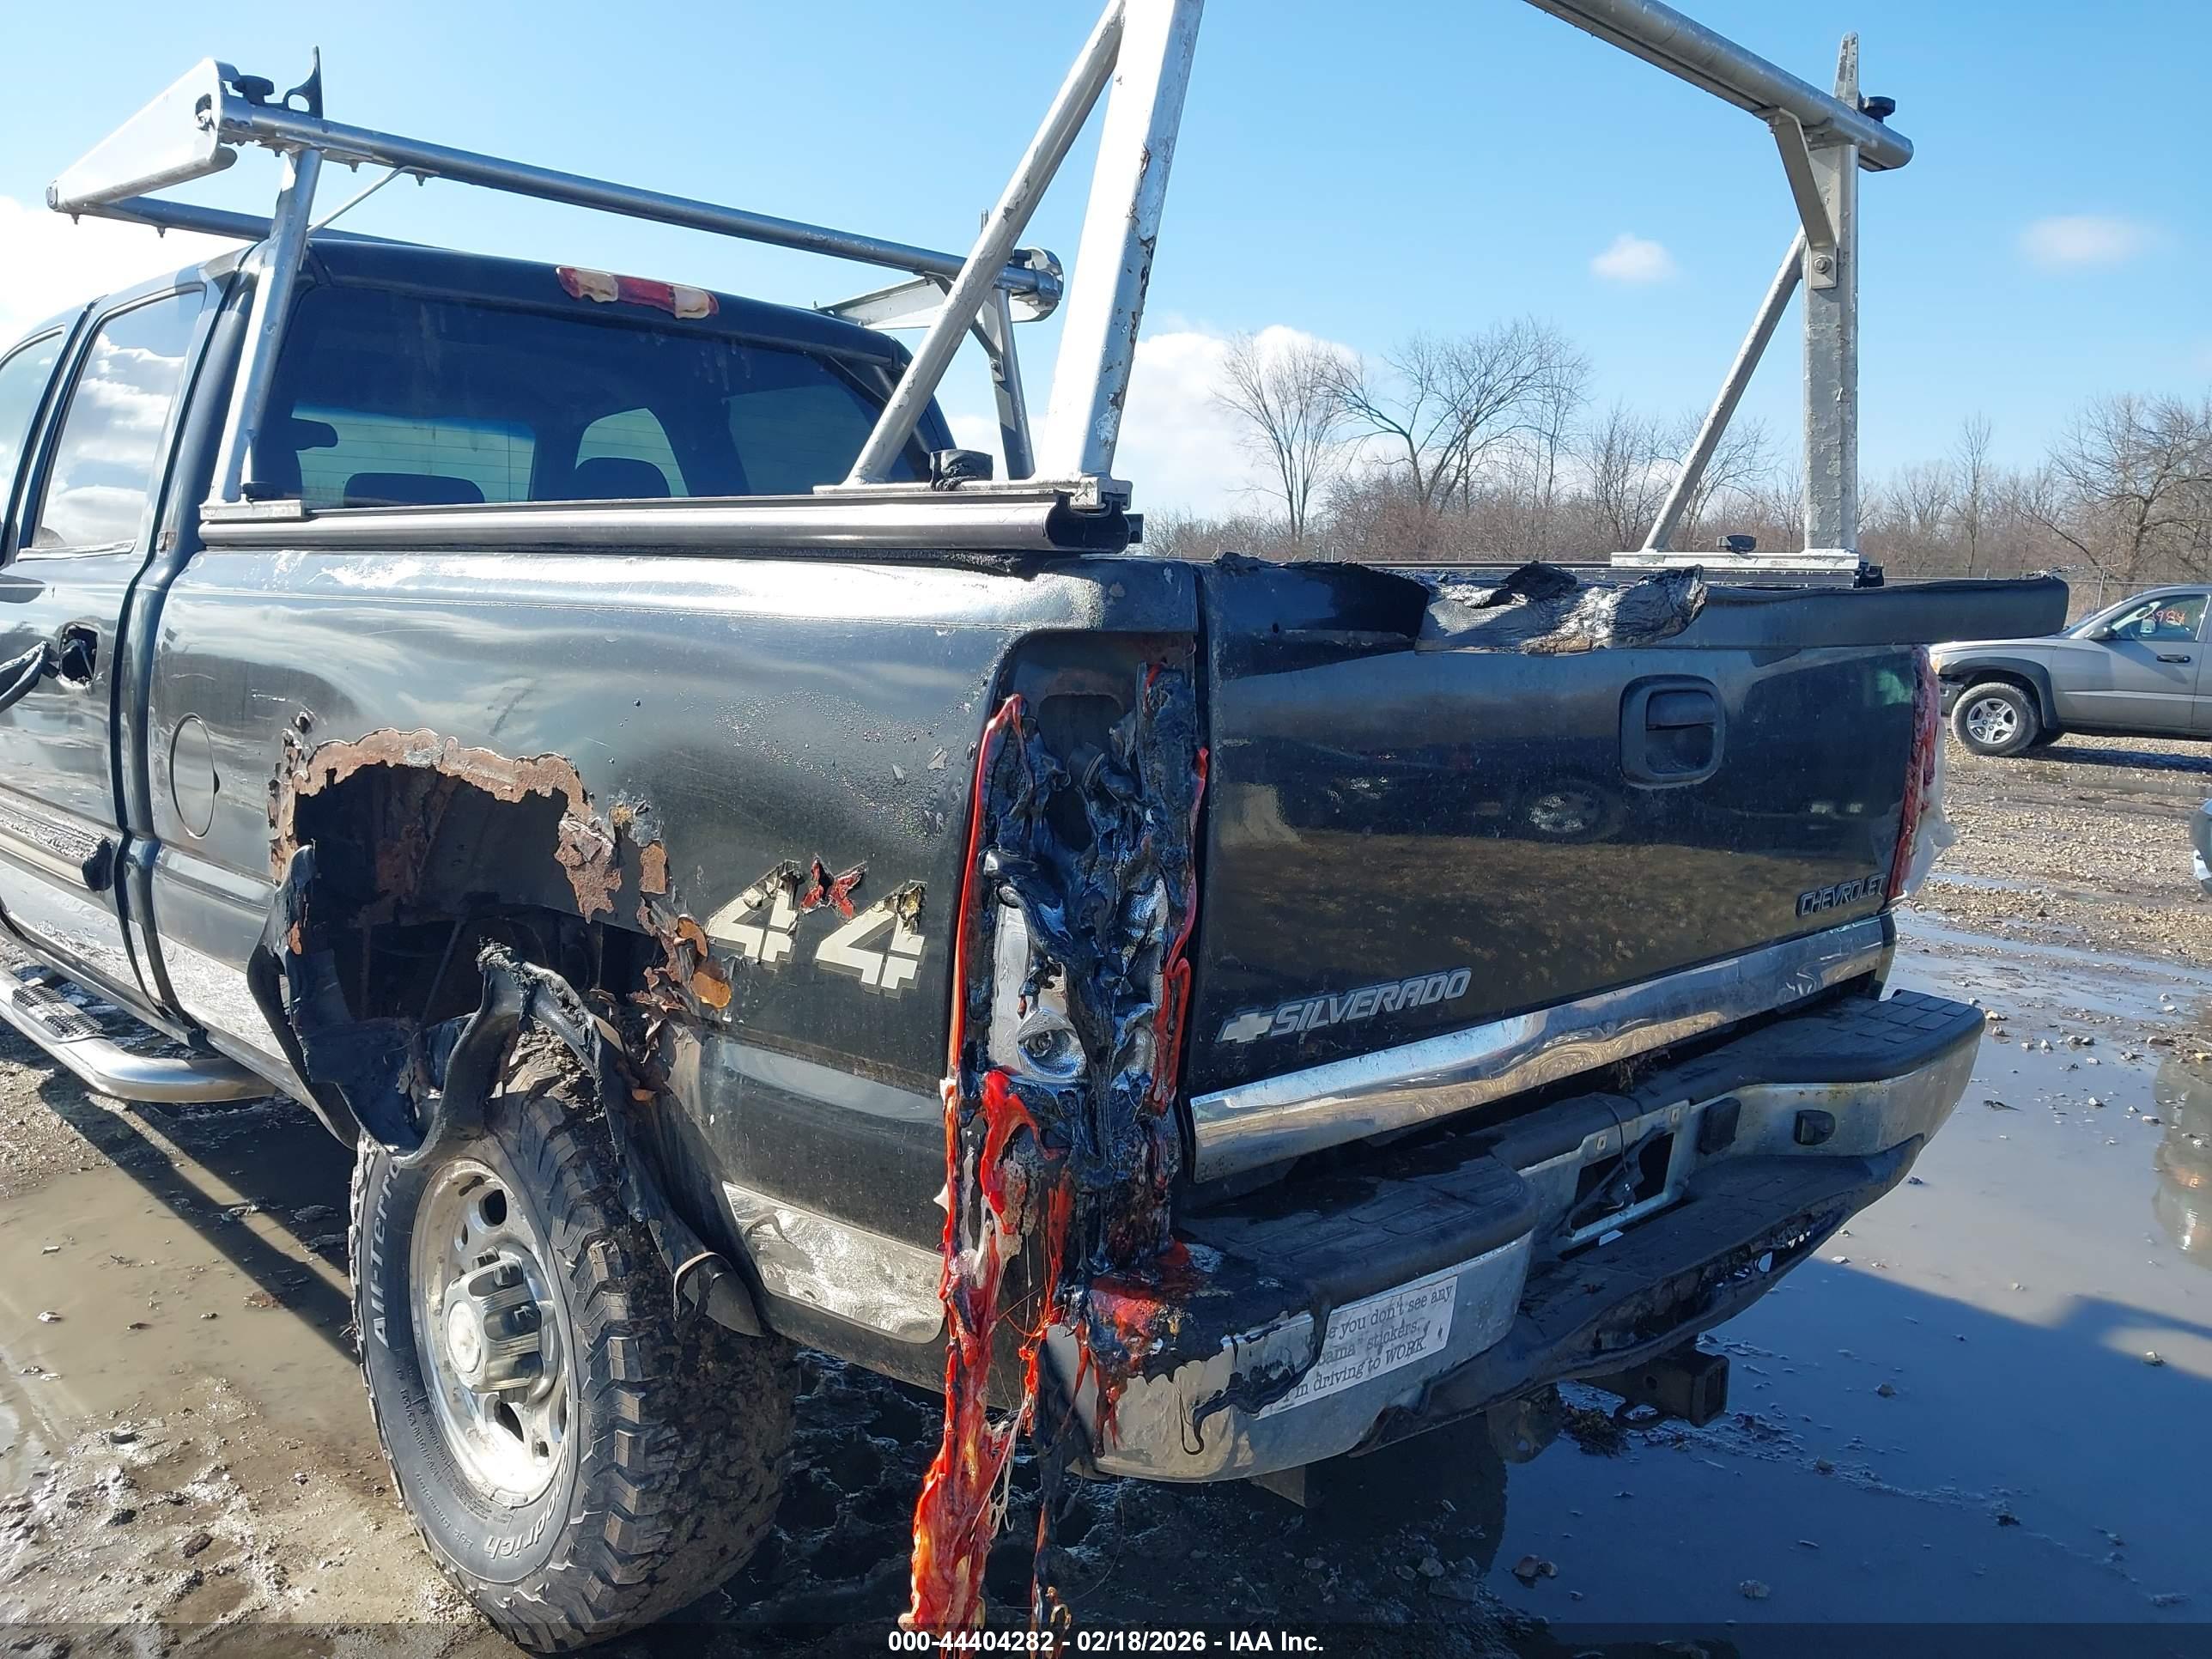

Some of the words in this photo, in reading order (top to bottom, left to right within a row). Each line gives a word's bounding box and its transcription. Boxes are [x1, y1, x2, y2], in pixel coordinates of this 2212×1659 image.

[1800, 873, 1887, 916] CHEVROLET
[1270, 969, 1473, 1037] SILVERADO
[370, 1160, 402, 1349] All-Terra
[1339, 1314, 1366, 1340] you
[1370, 1296, 1405, 1326] don't
[1408, 1296, 1427, 1313] see
[1431, 1285, 1453, 1303] any
[1313, 1359, 1366, 1391] driving
[1368, 1358, 1382, 1373] to
